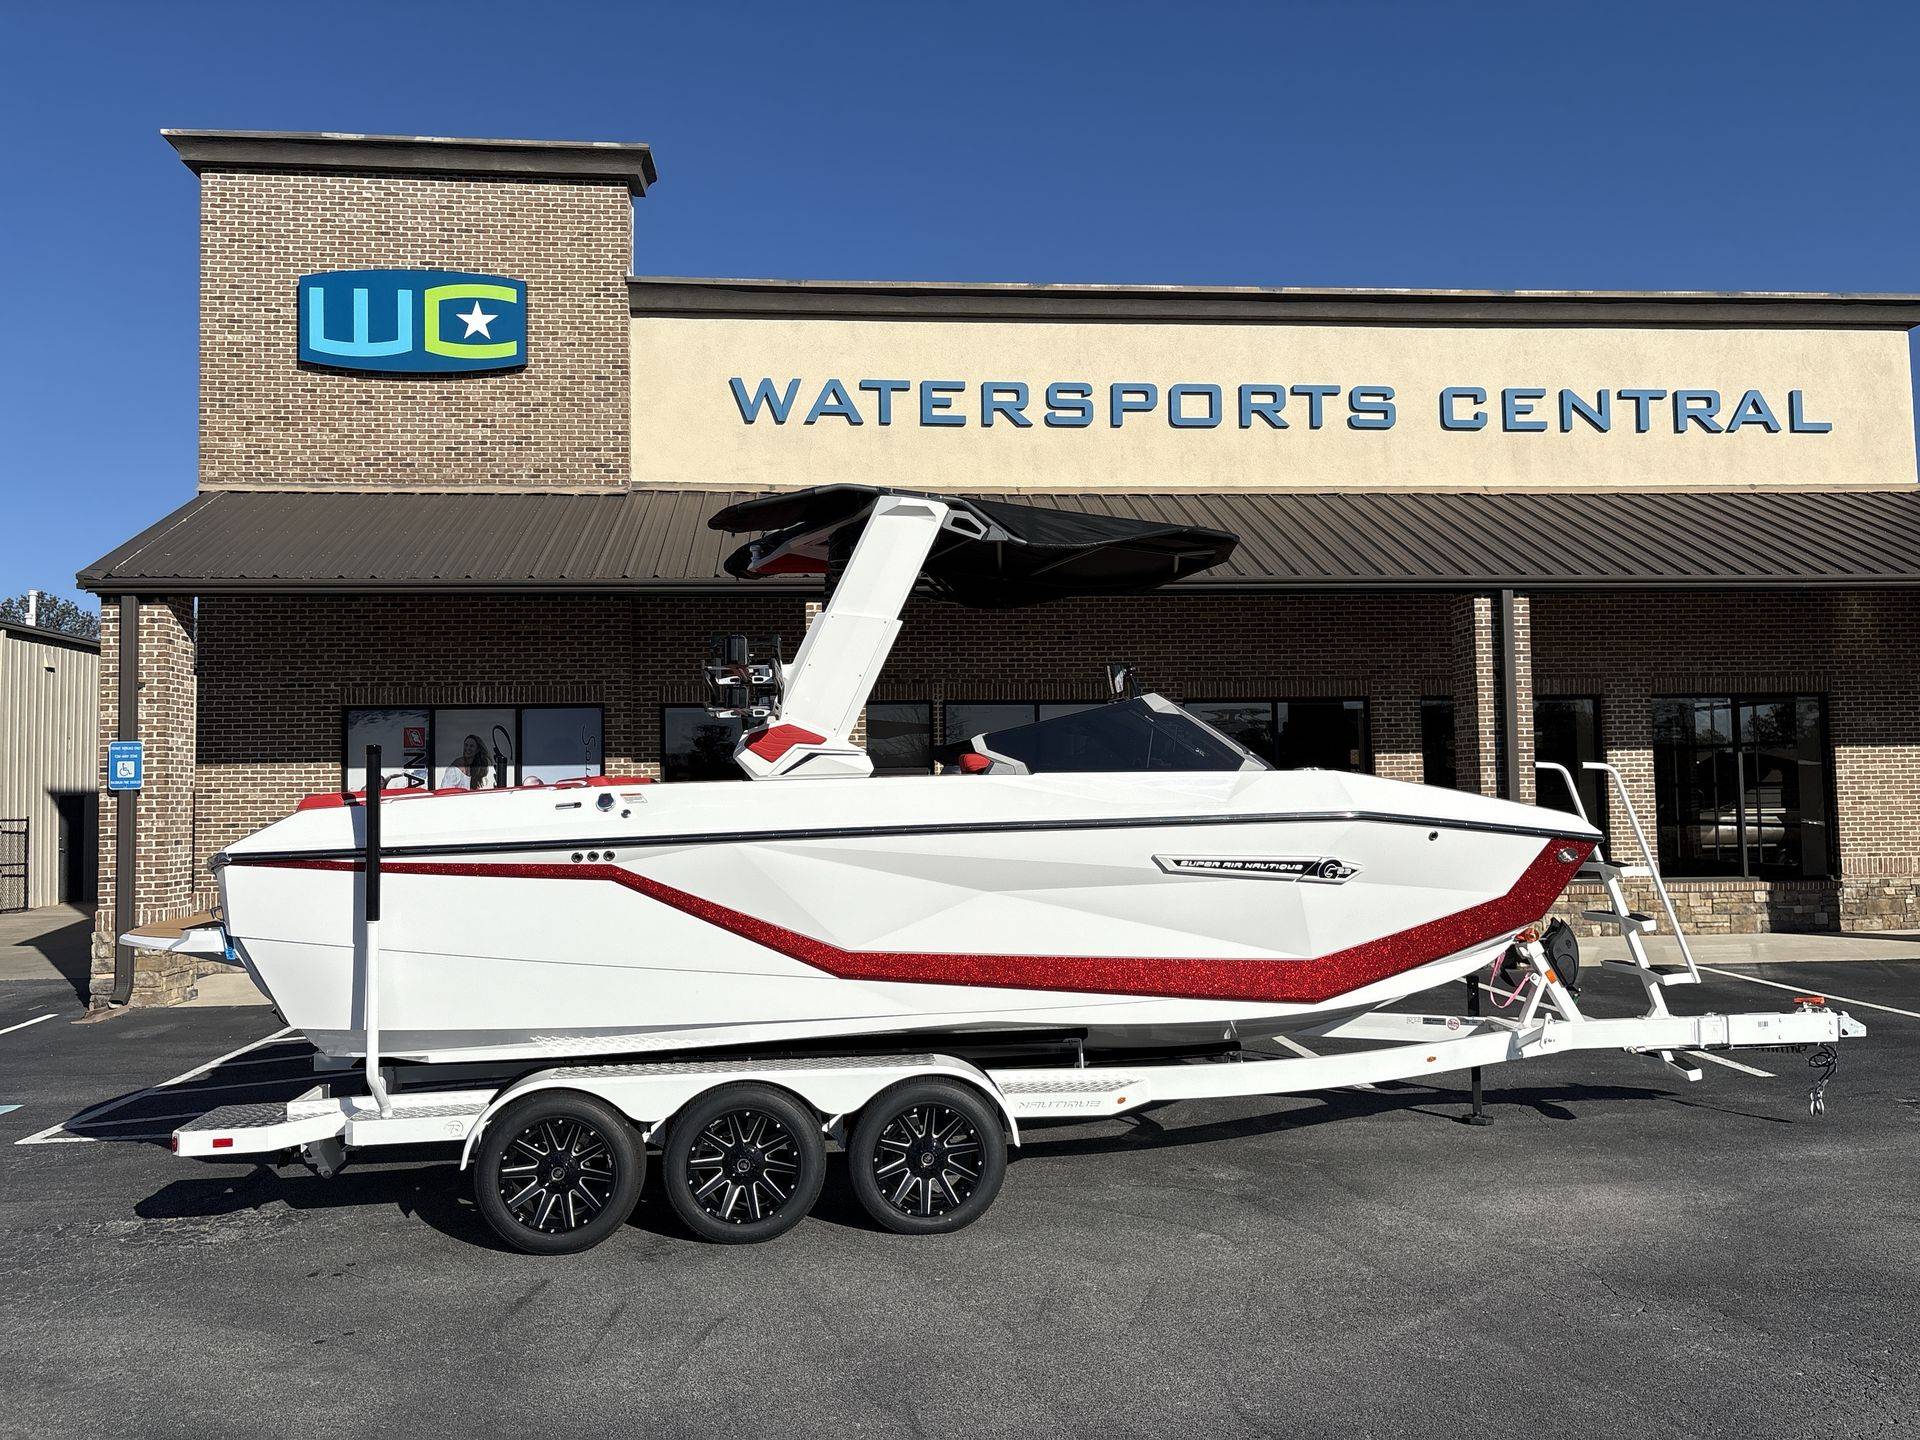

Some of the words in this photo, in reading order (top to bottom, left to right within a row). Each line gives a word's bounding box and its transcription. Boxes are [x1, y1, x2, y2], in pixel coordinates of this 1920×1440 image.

[309, 284, 517, 359] WC
[728, 377, 1398, 430] WATERSPORTS
[1438, 386, 1833, 434] CENTRAL
[1180, 860, 1221, 868] SUPER
[1222, 861, 1243, 869] AIR
[1244, 862, 1304, 871] NAUTIQUE
